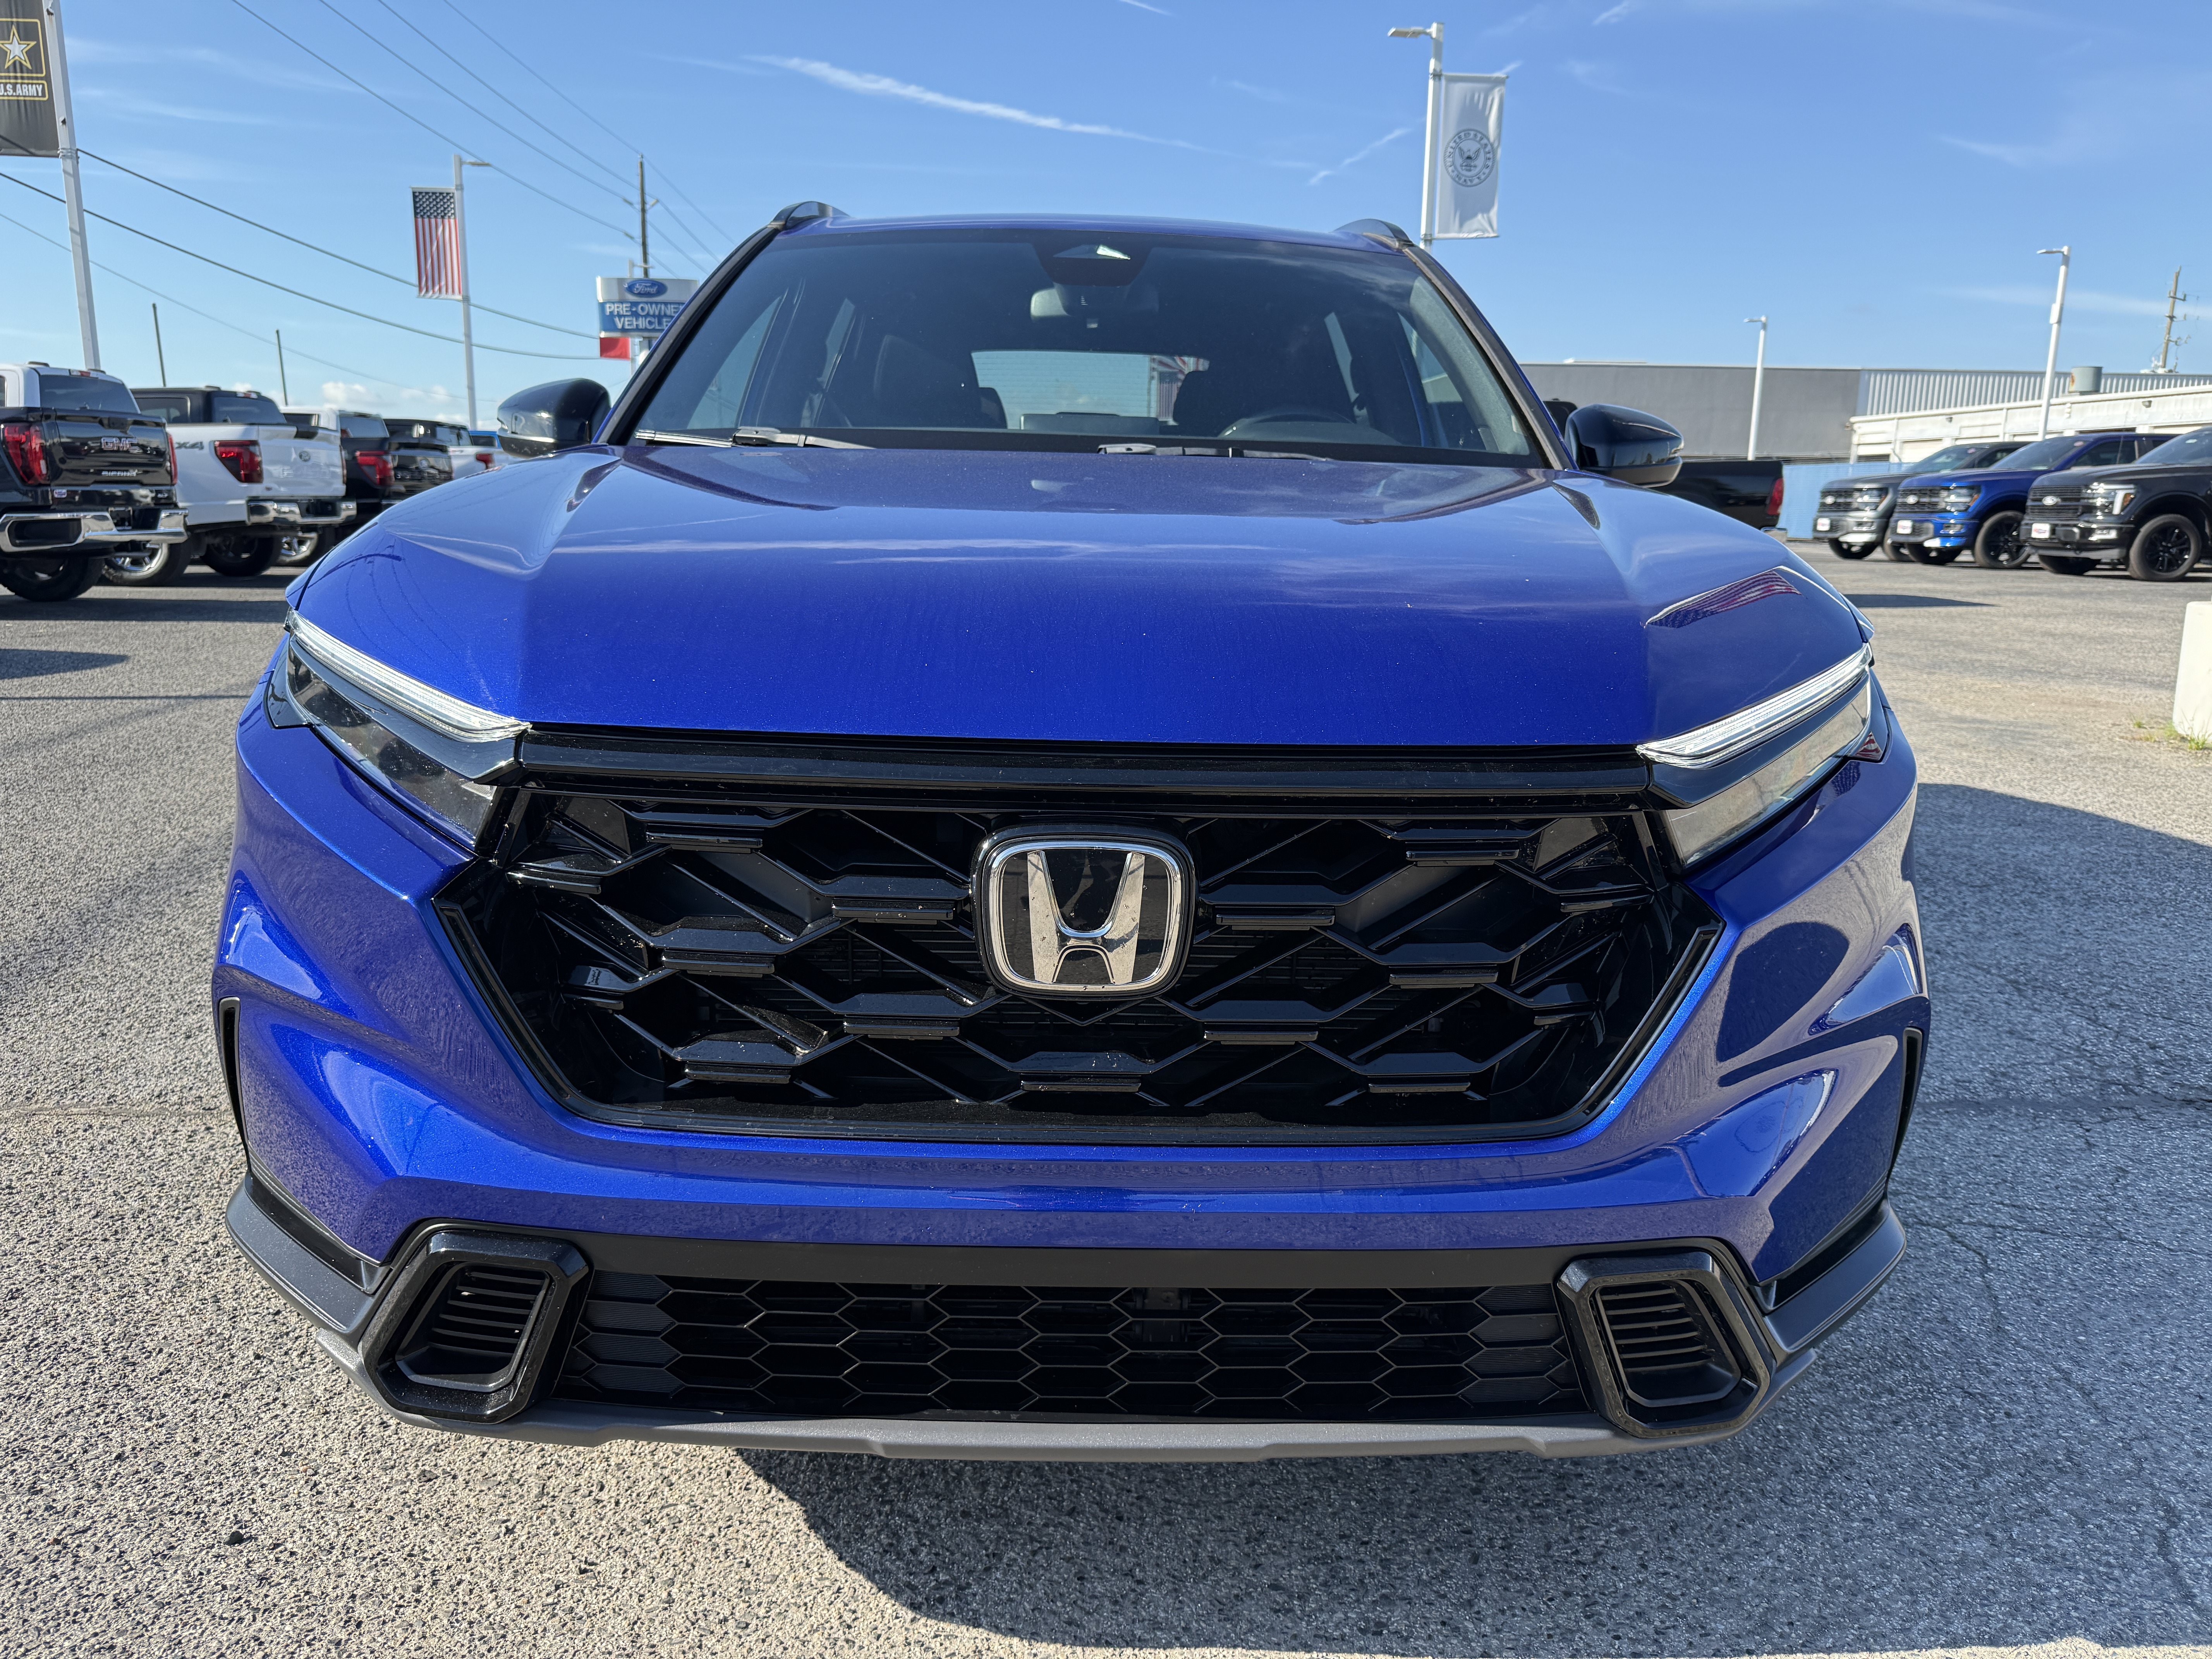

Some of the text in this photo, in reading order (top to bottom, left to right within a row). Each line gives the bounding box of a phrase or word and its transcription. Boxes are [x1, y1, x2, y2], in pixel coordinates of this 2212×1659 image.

[633, 283, 658, 294] Ford
[614, 316, 672, 329] VEHICLE
[101, 437, 139, 451] GMC
[175, 441, 204, 450] X4
